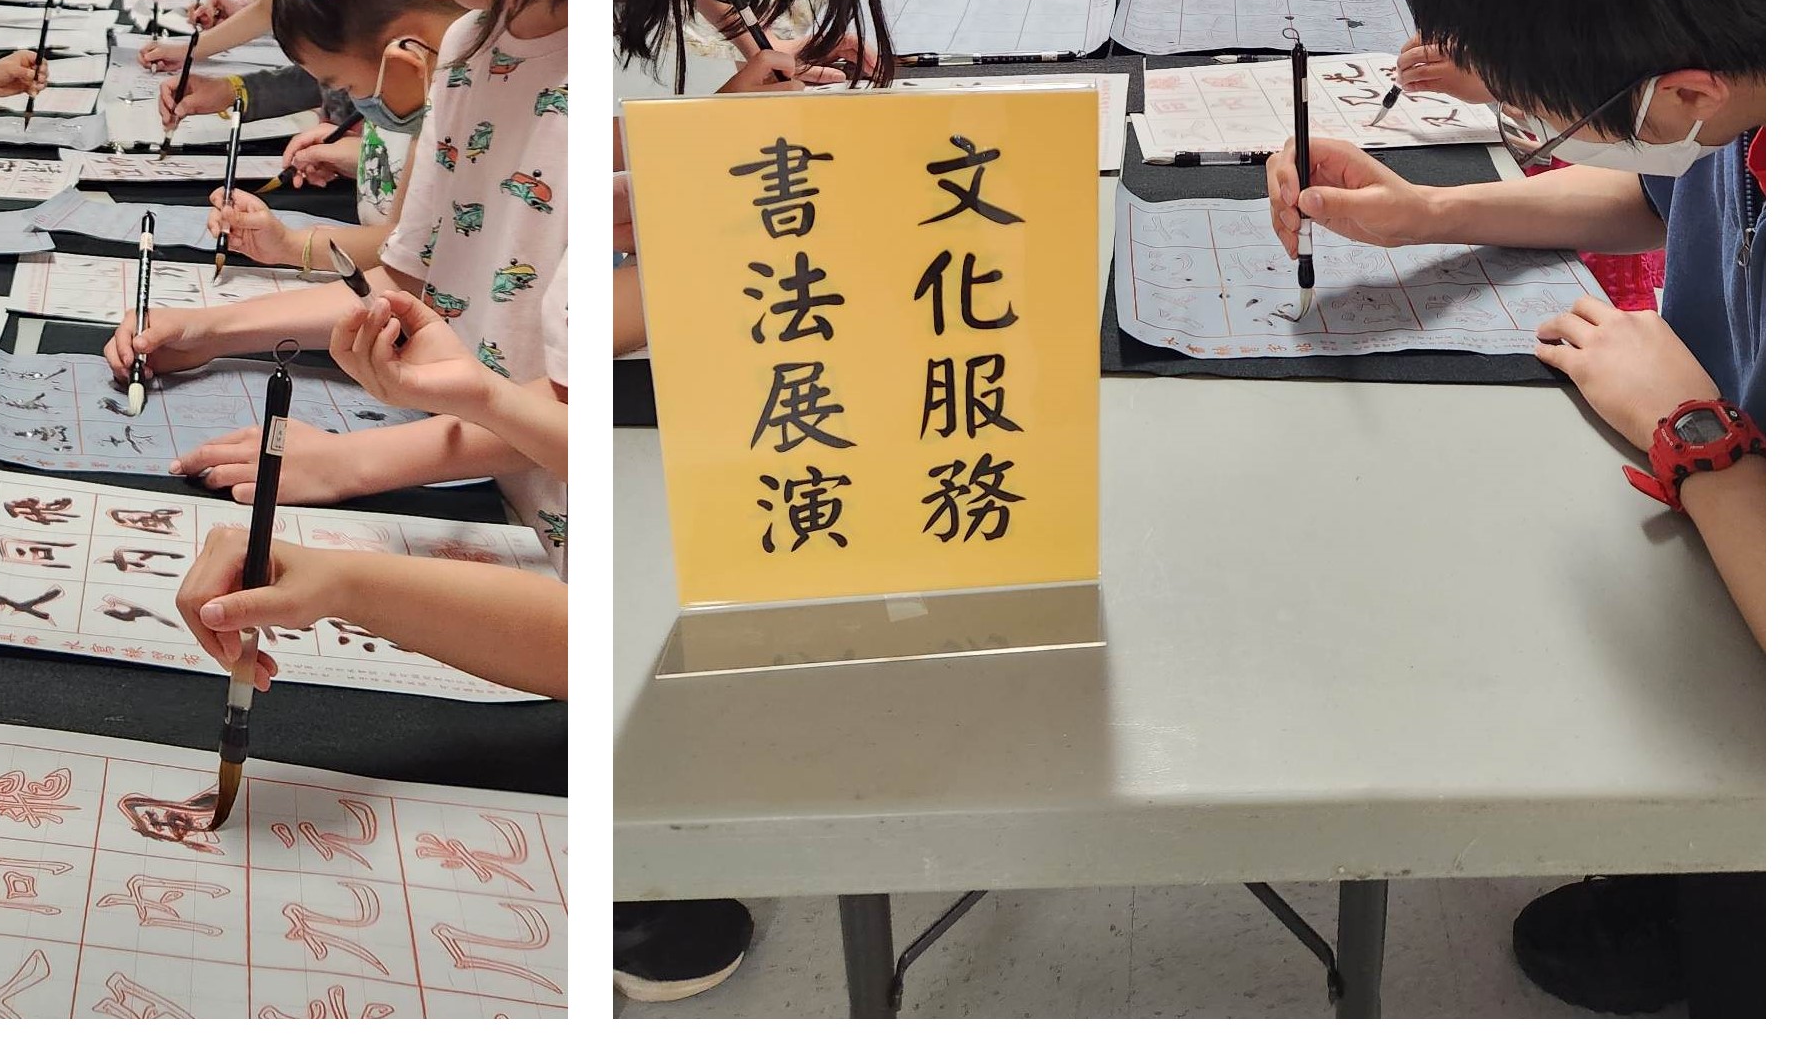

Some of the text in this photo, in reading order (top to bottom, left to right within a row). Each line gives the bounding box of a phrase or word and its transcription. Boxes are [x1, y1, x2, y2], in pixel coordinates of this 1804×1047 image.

[727, 136, 859, 554] 書法展演
[912, 133, 1027, 544] 文化服務
